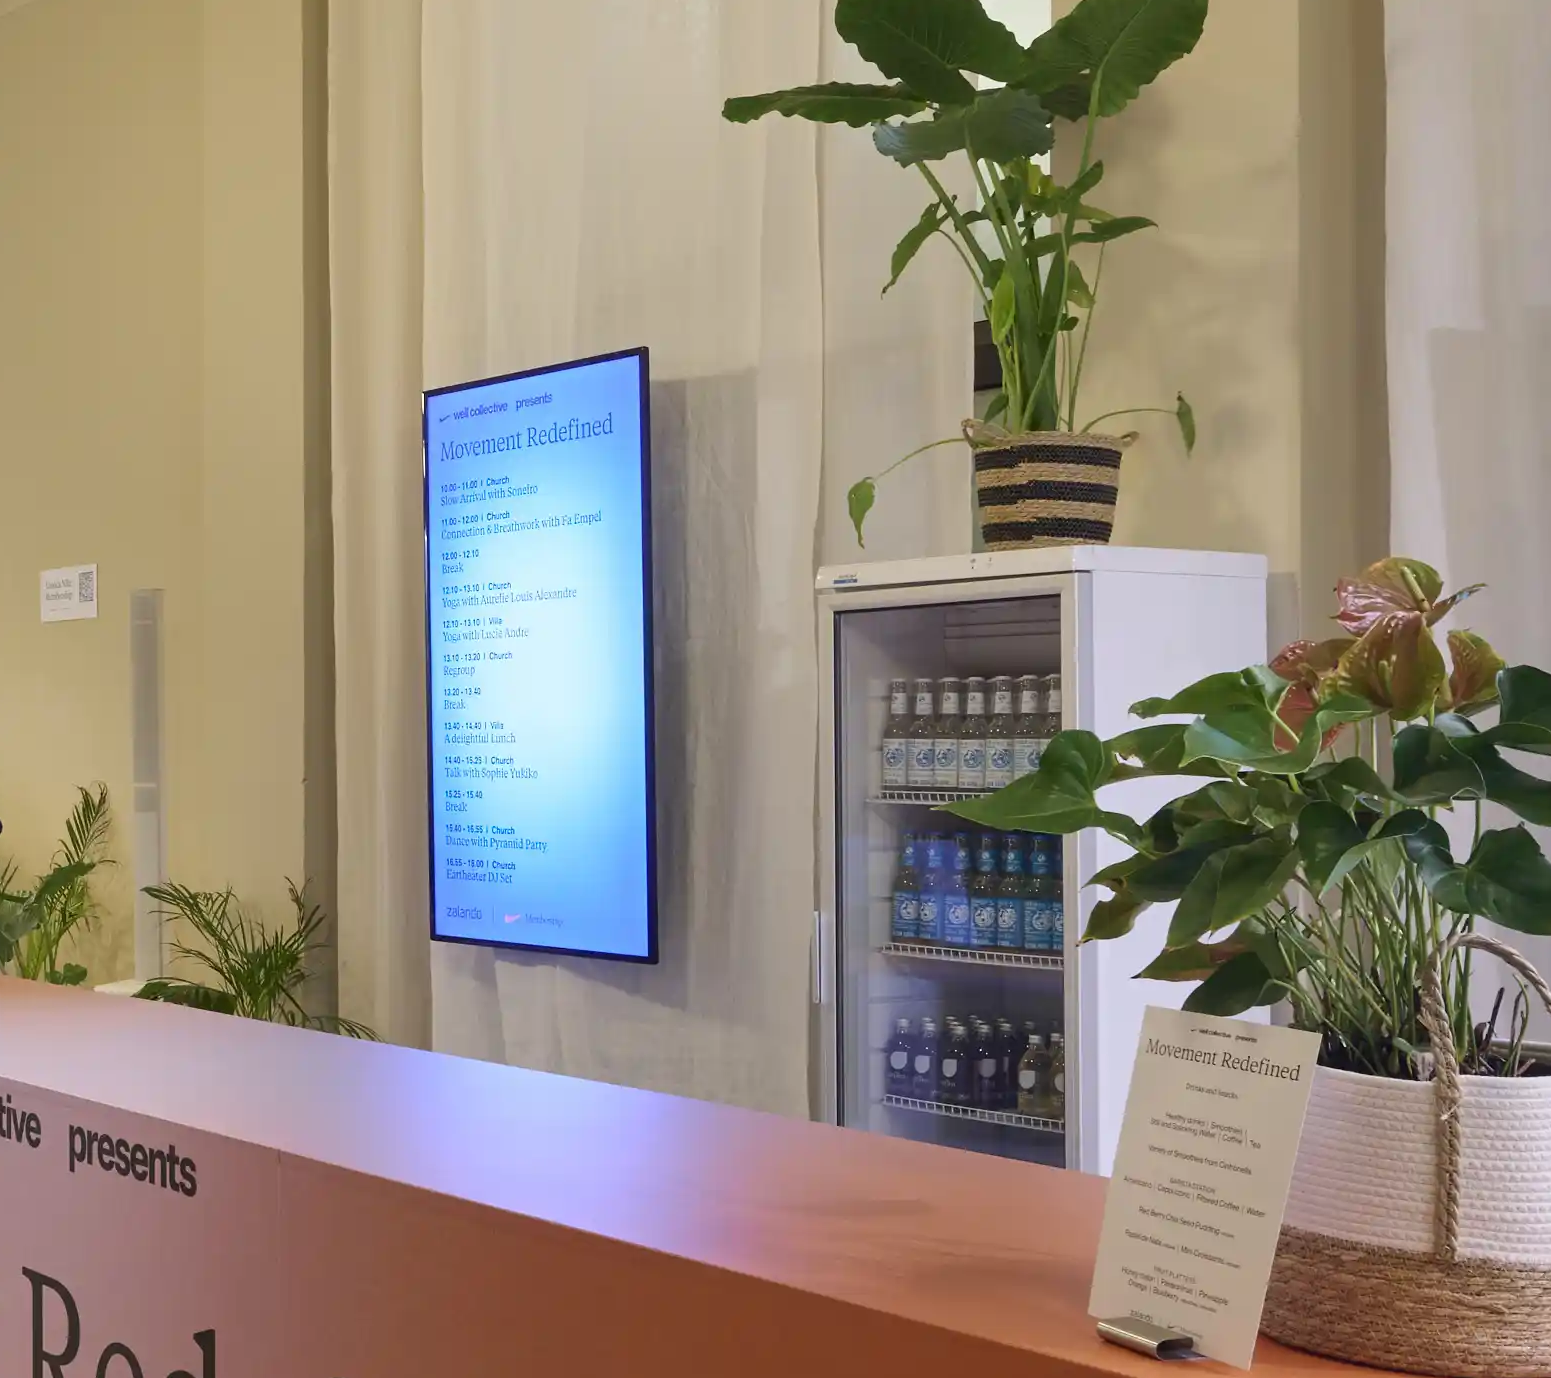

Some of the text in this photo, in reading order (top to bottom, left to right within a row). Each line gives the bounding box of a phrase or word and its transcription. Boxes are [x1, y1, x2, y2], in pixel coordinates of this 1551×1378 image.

[515, 393, 553, 412] presents
[439, 412, 614, 461] Movement Redefined
[487, 487, 506, 500] with
[541, 515, 560, 528] with
[441, 561, 464, 574] Break
[461, 594, 479, 606] with
[443, 698, 466, 710] Break
[444, 801, 467, 812] Break
[470, 836, 488, 847] with
[525, 839, 547, 853] Party
[1146, 1038, 1301, 1081] Movement Redefined
[68, 1123, 198, 1198] presents
